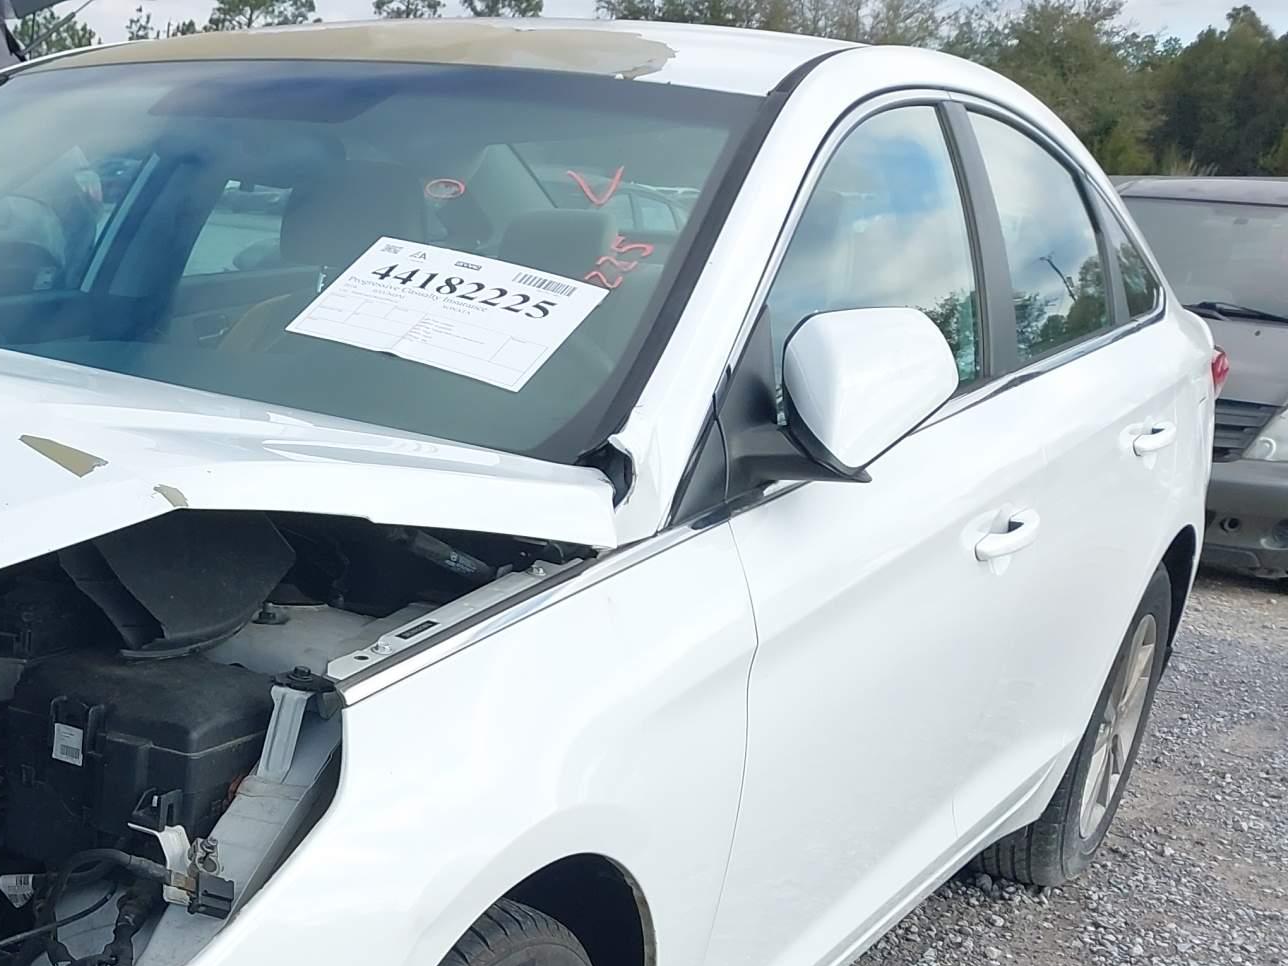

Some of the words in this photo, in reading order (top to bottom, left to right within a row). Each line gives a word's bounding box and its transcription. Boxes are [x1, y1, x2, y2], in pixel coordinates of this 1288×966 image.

[348, 275, 401, 292] Progressive
[401, 285, 440, 301] Casualty
[442, 296, 488, 312] Insurance
[371, 263, 558, 319] 44182225
